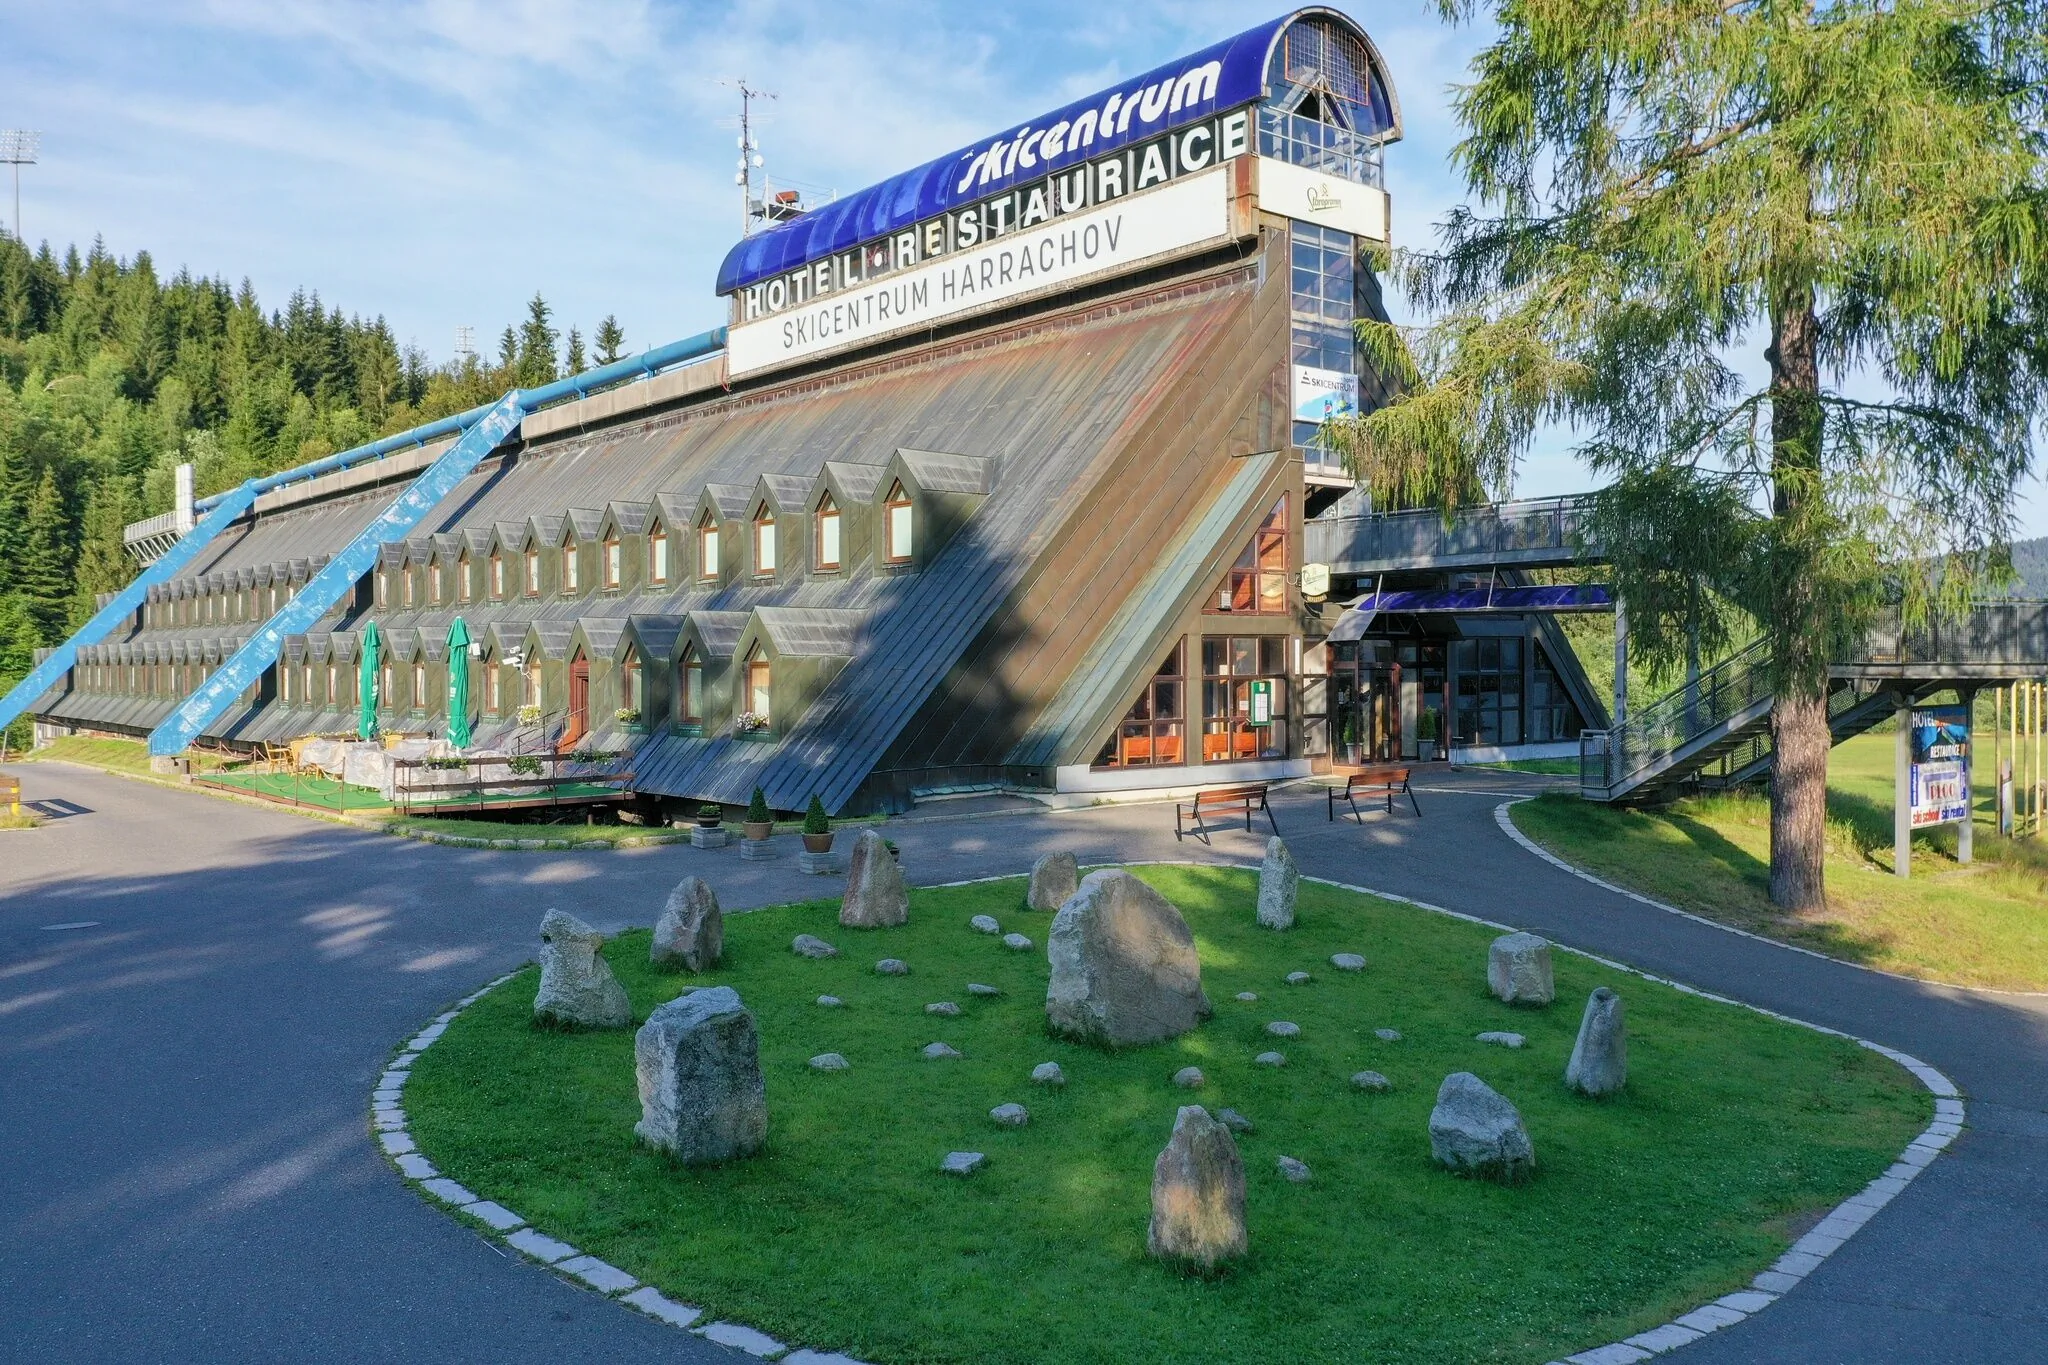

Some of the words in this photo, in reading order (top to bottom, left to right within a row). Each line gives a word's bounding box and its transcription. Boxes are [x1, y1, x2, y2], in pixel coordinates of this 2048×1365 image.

[957, 60, 1222, 194] skicentrum
[743, 254, 858, 320] HOTEL
[897, 111, 1247, 270] RESTAURACE
[783, 281, 928, 349] SKICENTRUM
[942, 214, 1123, 302] HARRACHOV
[1312, 377, 1355, 393] SKICENTRUM
[1912, 711, 1935, 728] HOTEL
